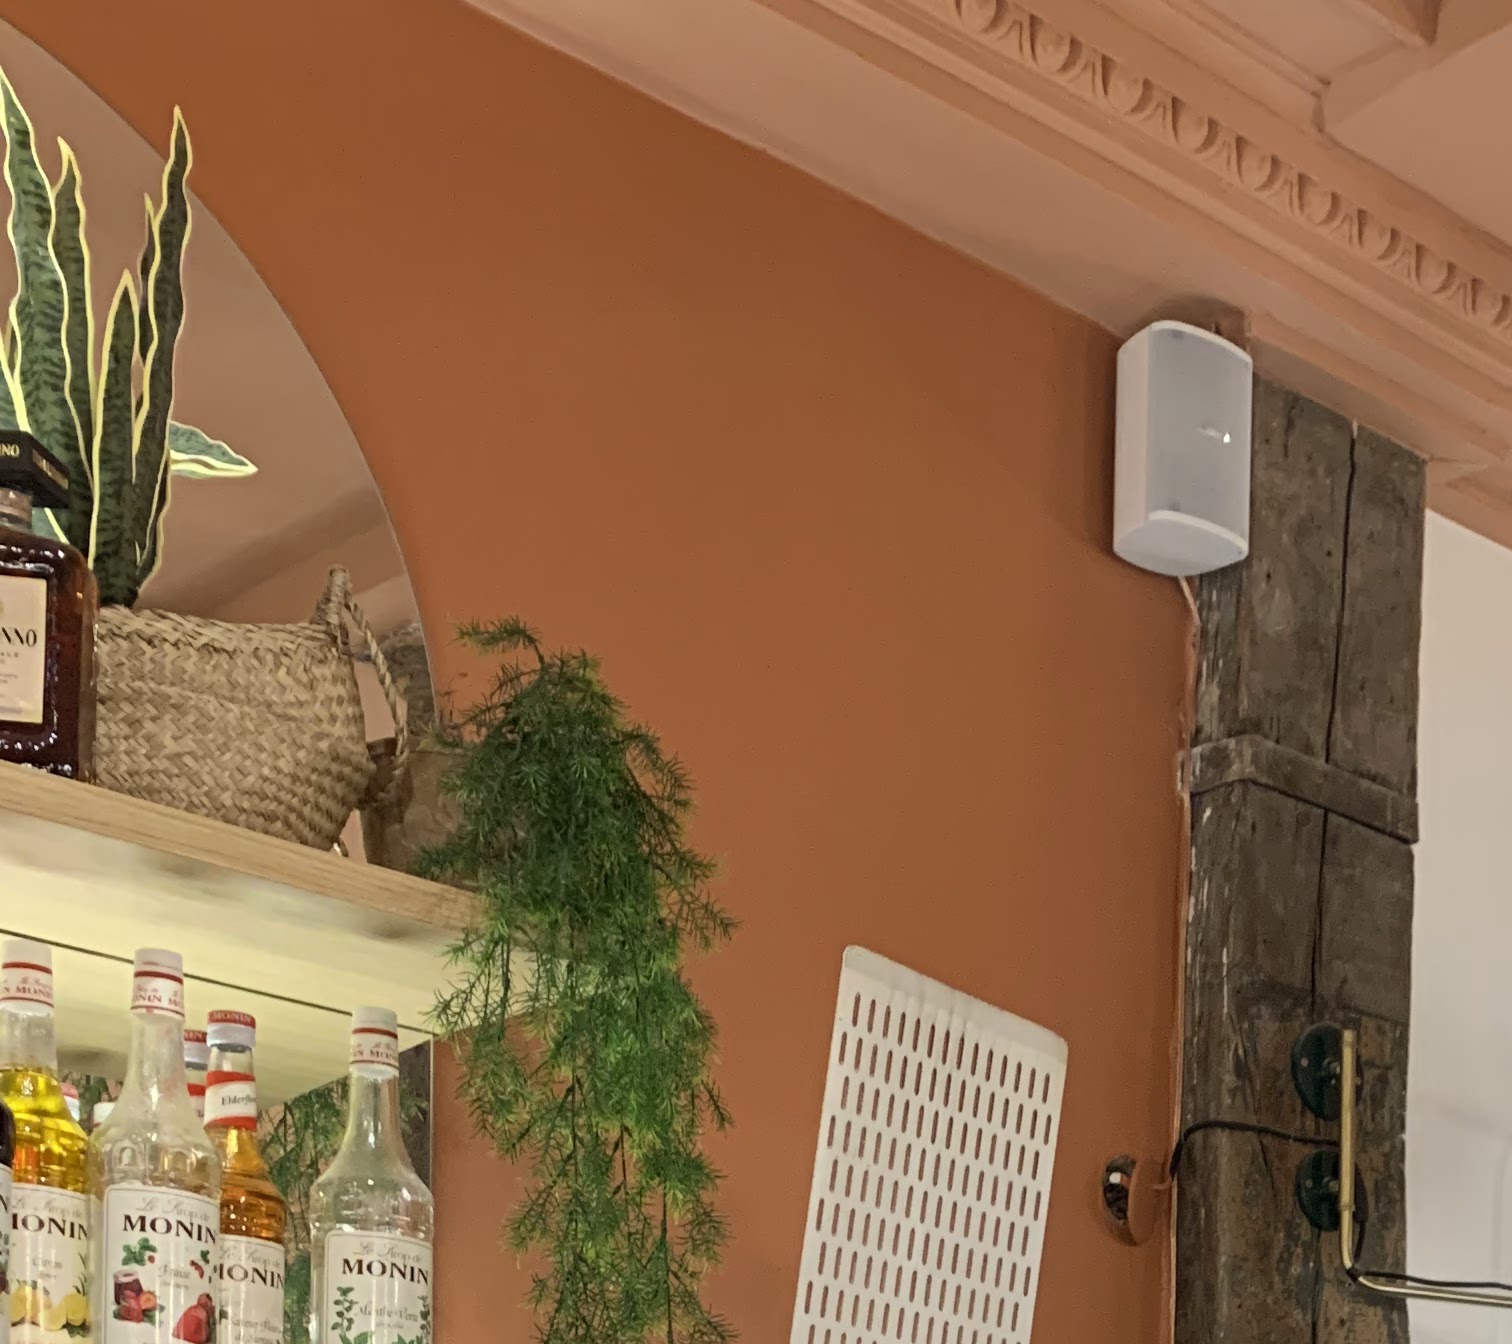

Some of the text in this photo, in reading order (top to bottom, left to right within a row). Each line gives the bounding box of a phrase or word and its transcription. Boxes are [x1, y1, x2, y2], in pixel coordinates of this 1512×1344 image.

[212, 1011, 252, 1023] MONIN
[122, 1213, 216, 1245] MONIN
[342, 1258, 429, 1286] MONIN
